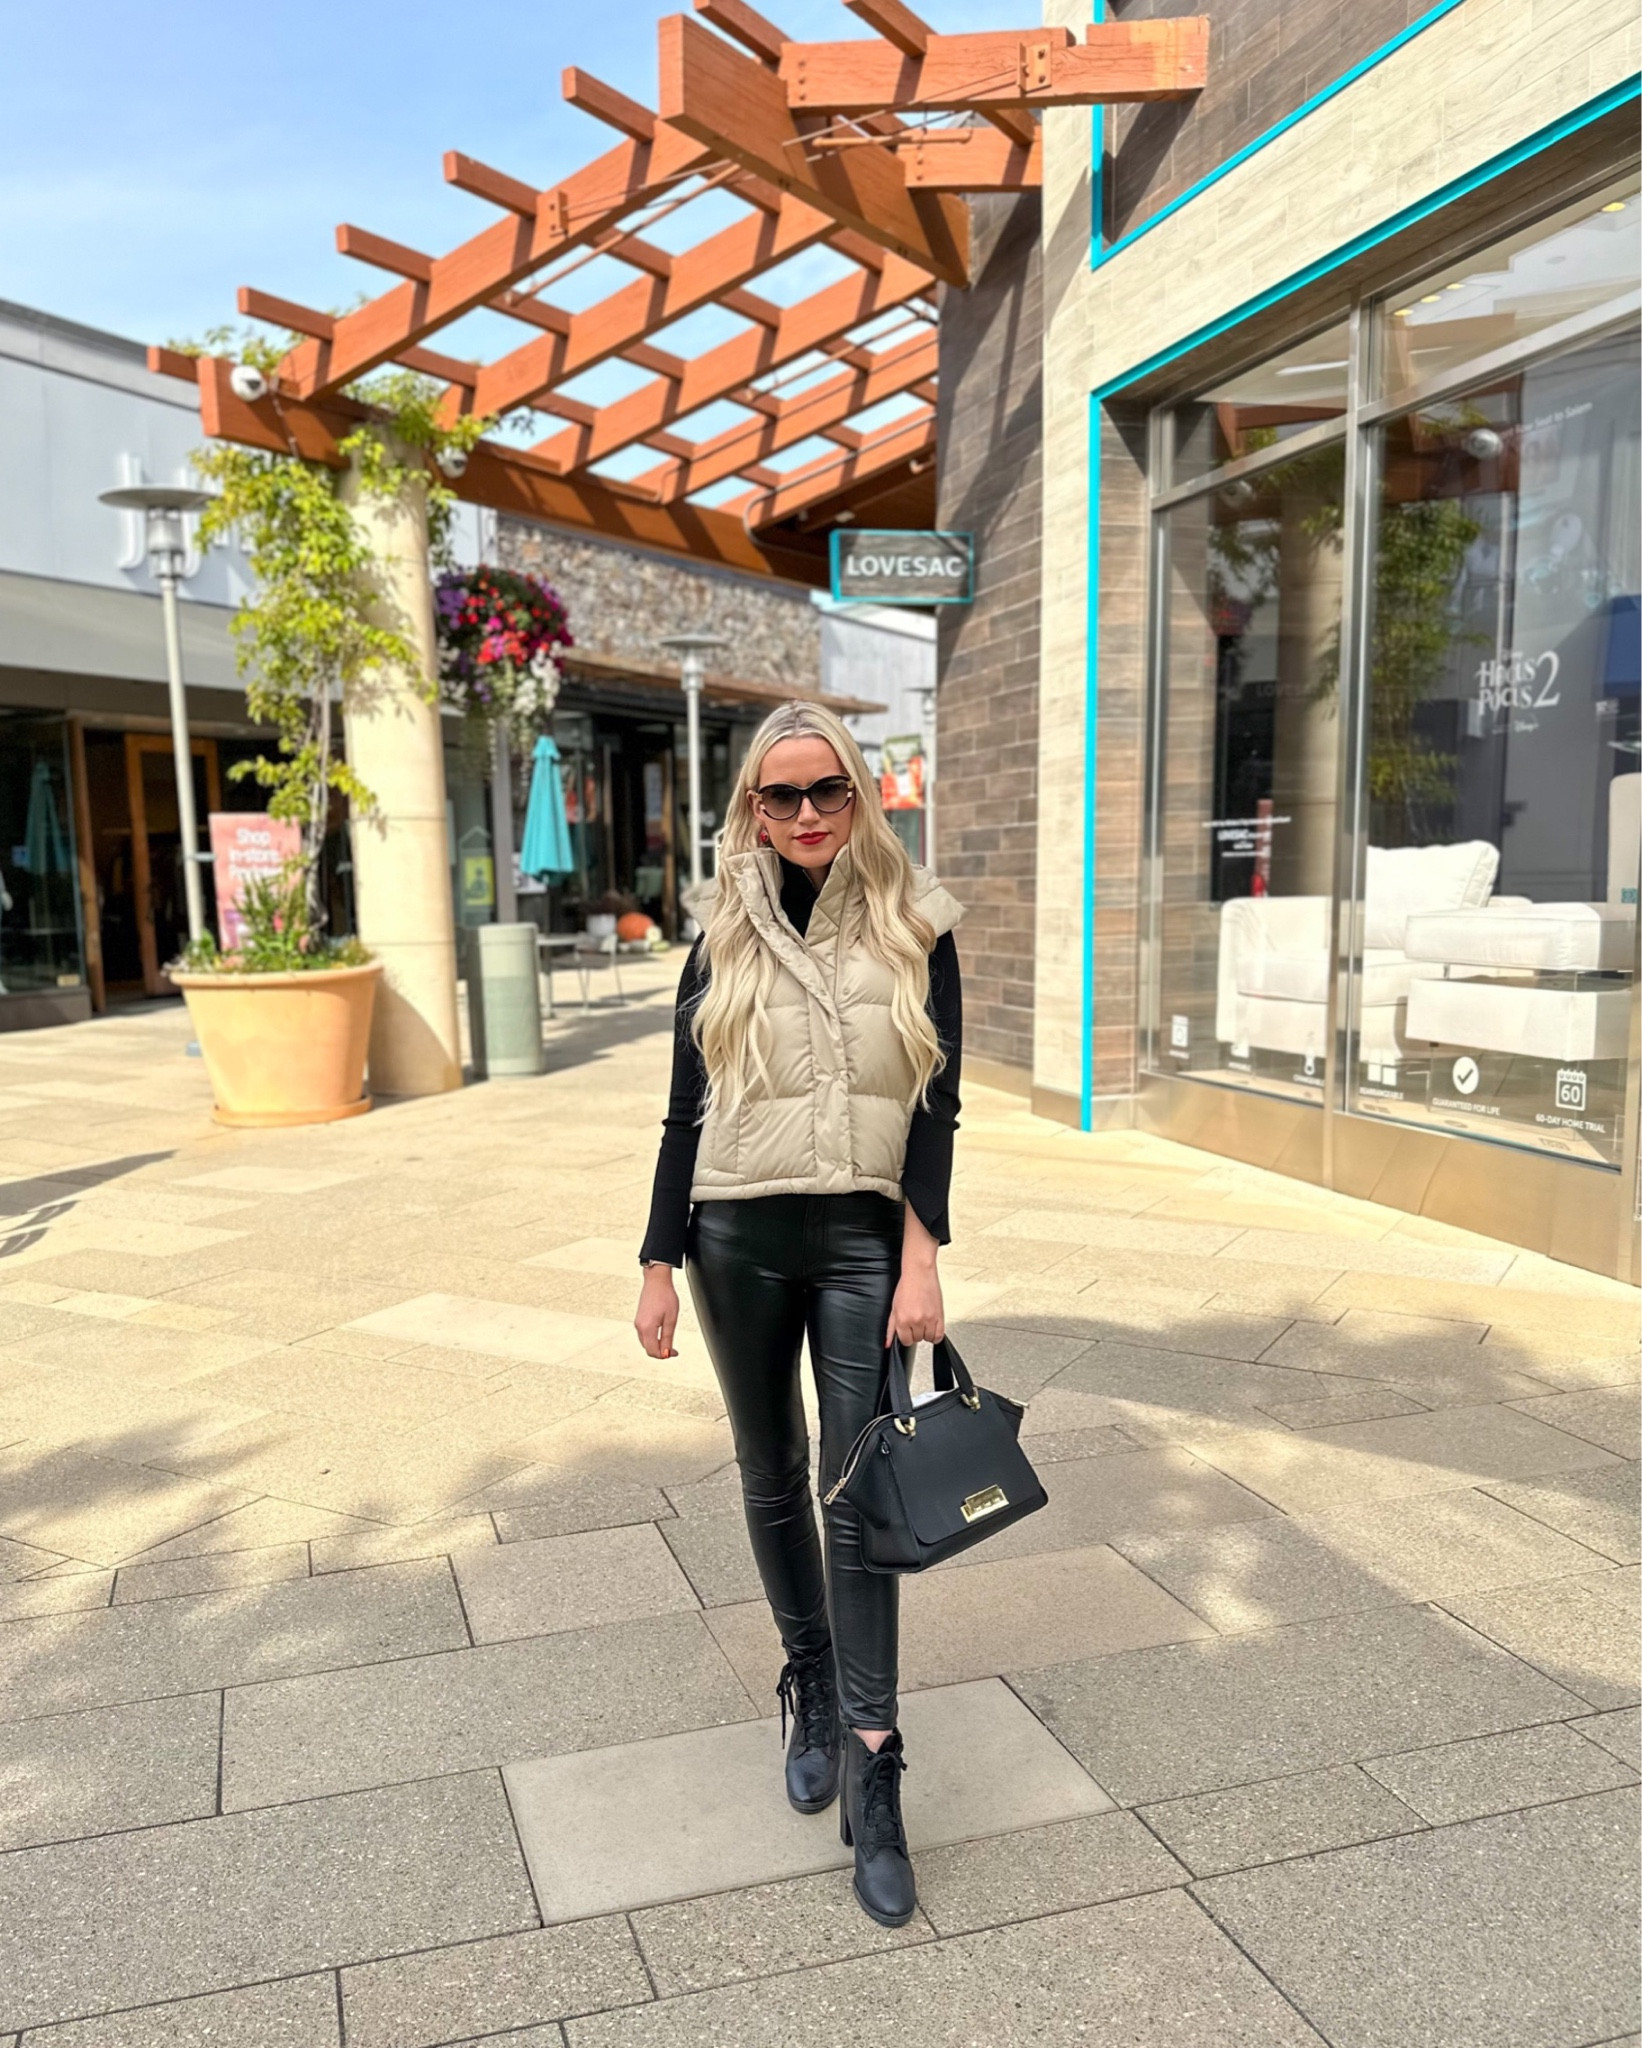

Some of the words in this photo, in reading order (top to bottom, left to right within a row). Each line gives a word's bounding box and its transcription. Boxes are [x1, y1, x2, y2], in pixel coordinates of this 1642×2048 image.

[846, 554, 963, 577] LOVESAC
[1561, 1084, 1581, 1104] 60
[1432, 1097, 1473, 1111] GUARANTEED
[1473, 1103, 1487, 1114] FOR
[1487, 1105, 1500, 1116] LIFE
[1535, 1113, 1560, 1125] 60-DAY
[1562, 1117, 1583, 1130] HOME
[1584, 1121, 1606, 1134] TRIAL
